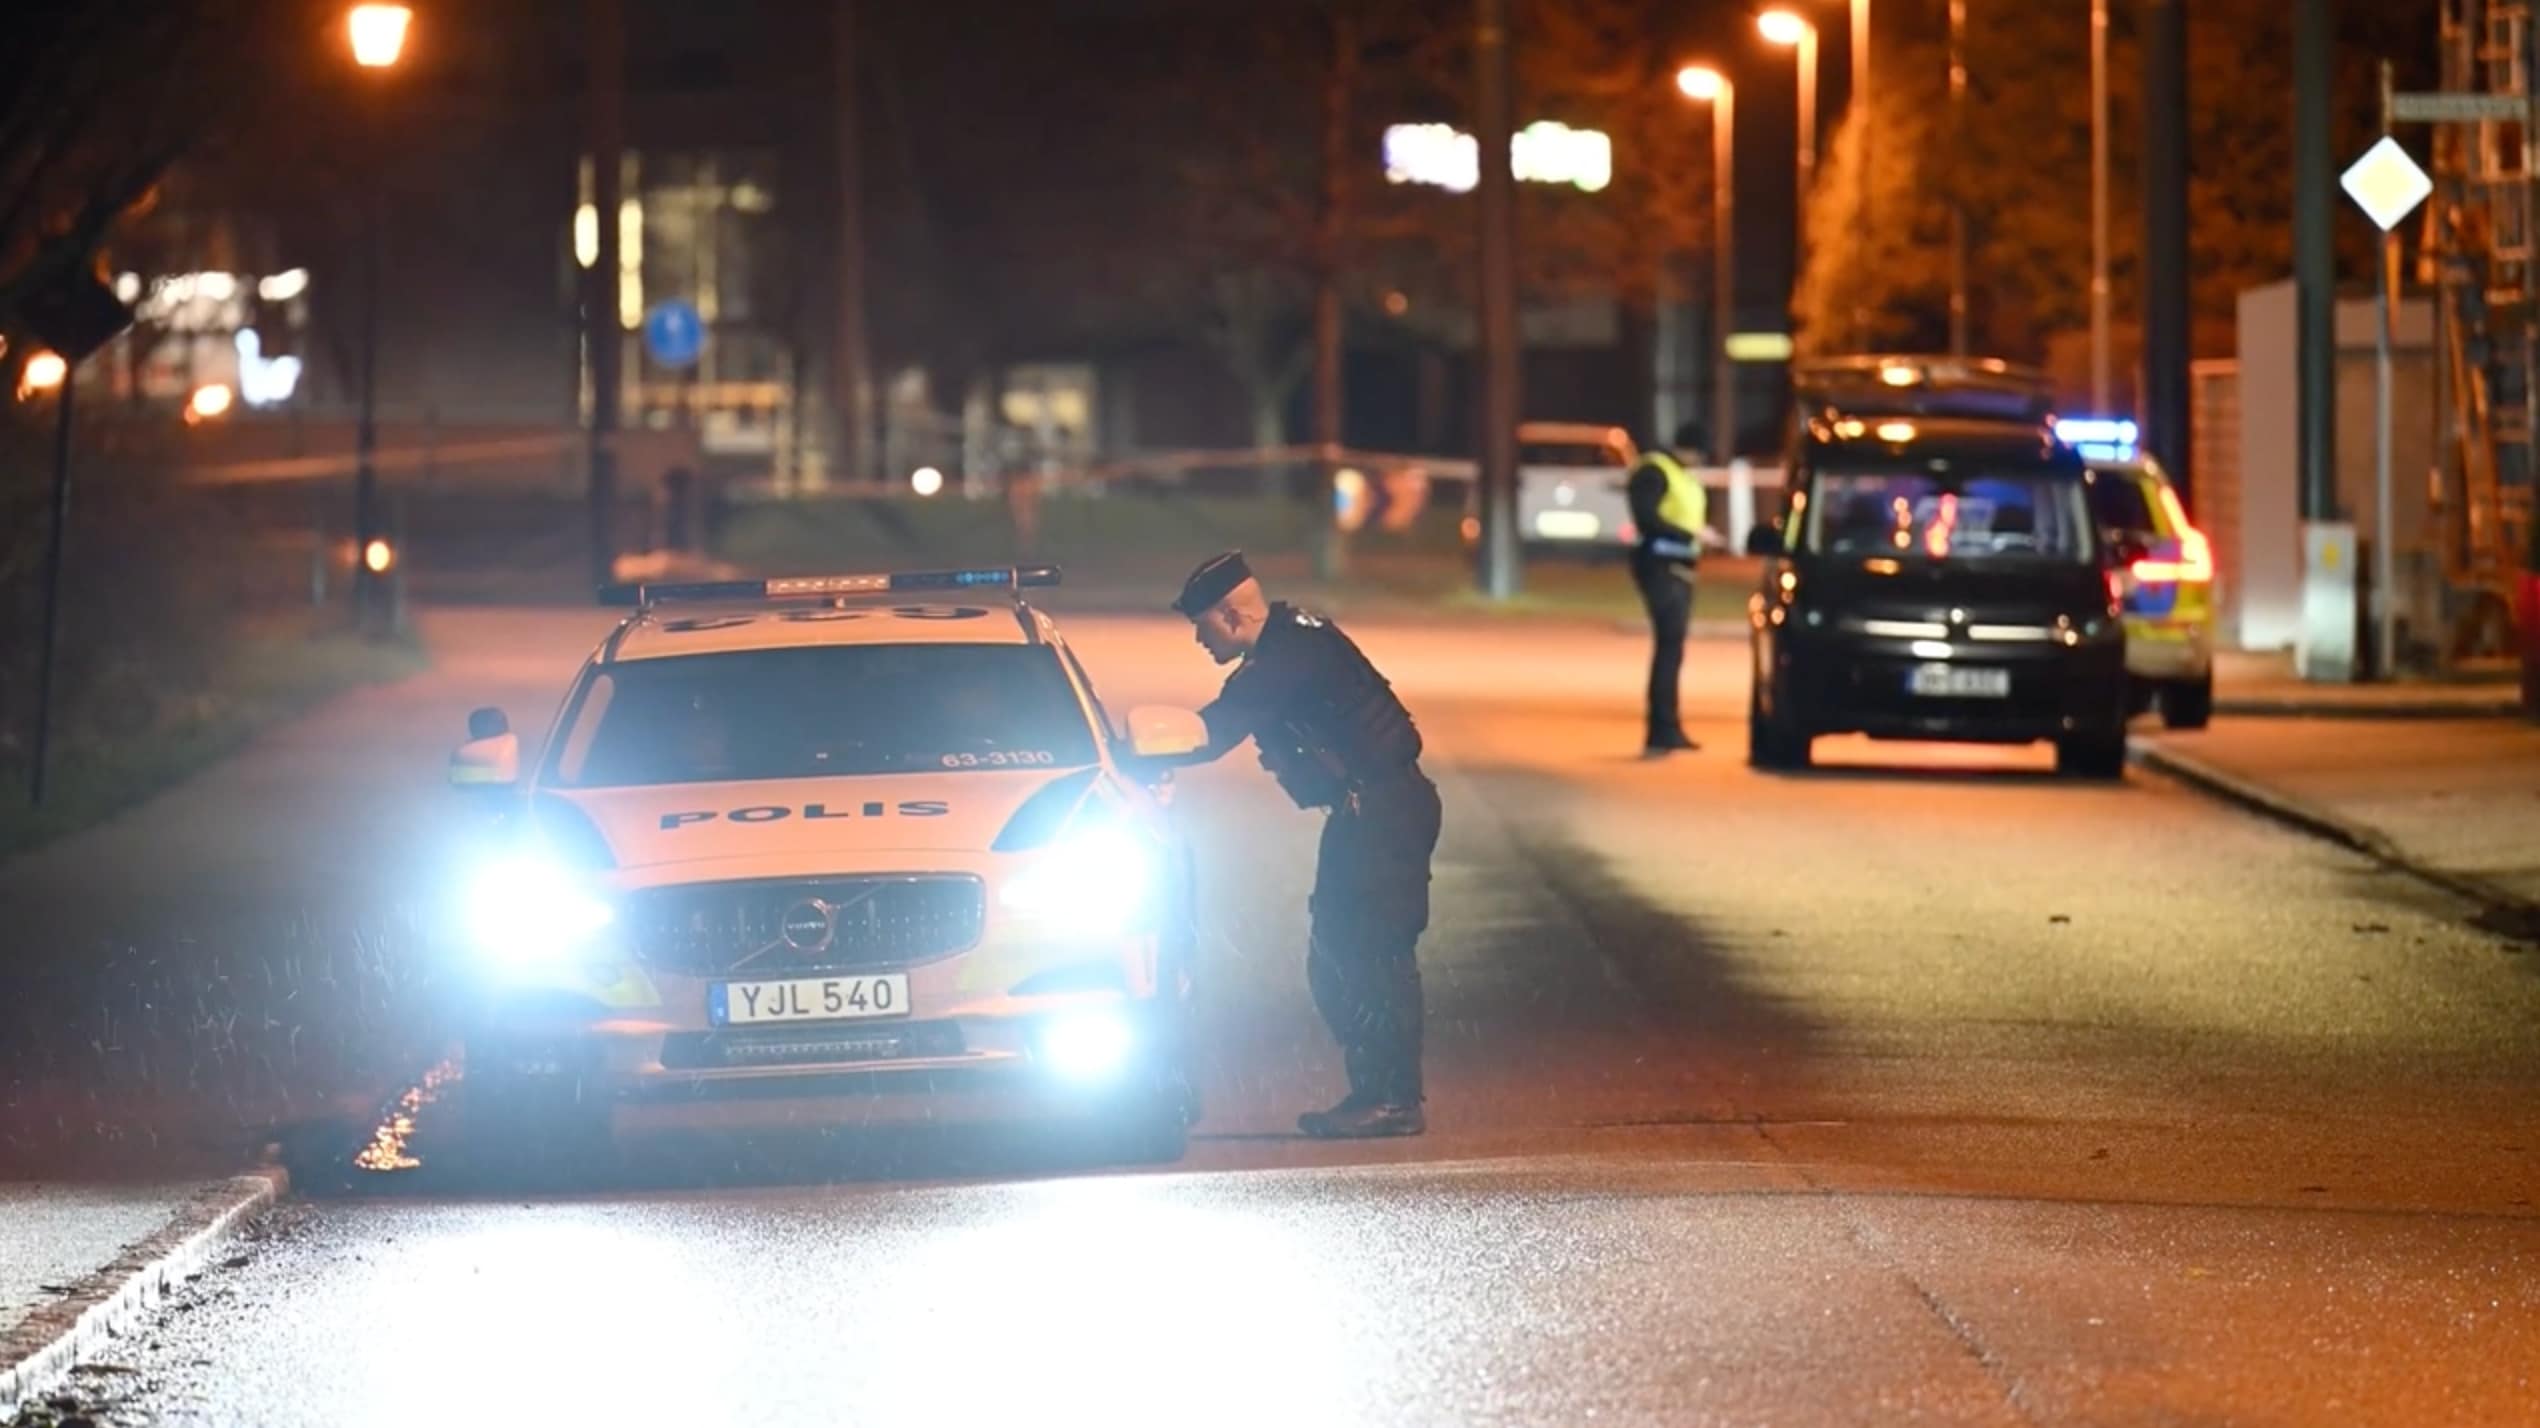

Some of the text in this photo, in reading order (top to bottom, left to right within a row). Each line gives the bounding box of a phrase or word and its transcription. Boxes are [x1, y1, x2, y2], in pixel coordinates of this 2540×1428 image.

[942, 751, 1054, 768] 63-3130
[660, 801, 949, 830] POLIS
[742, 979, 893, 1017] YJL 540
